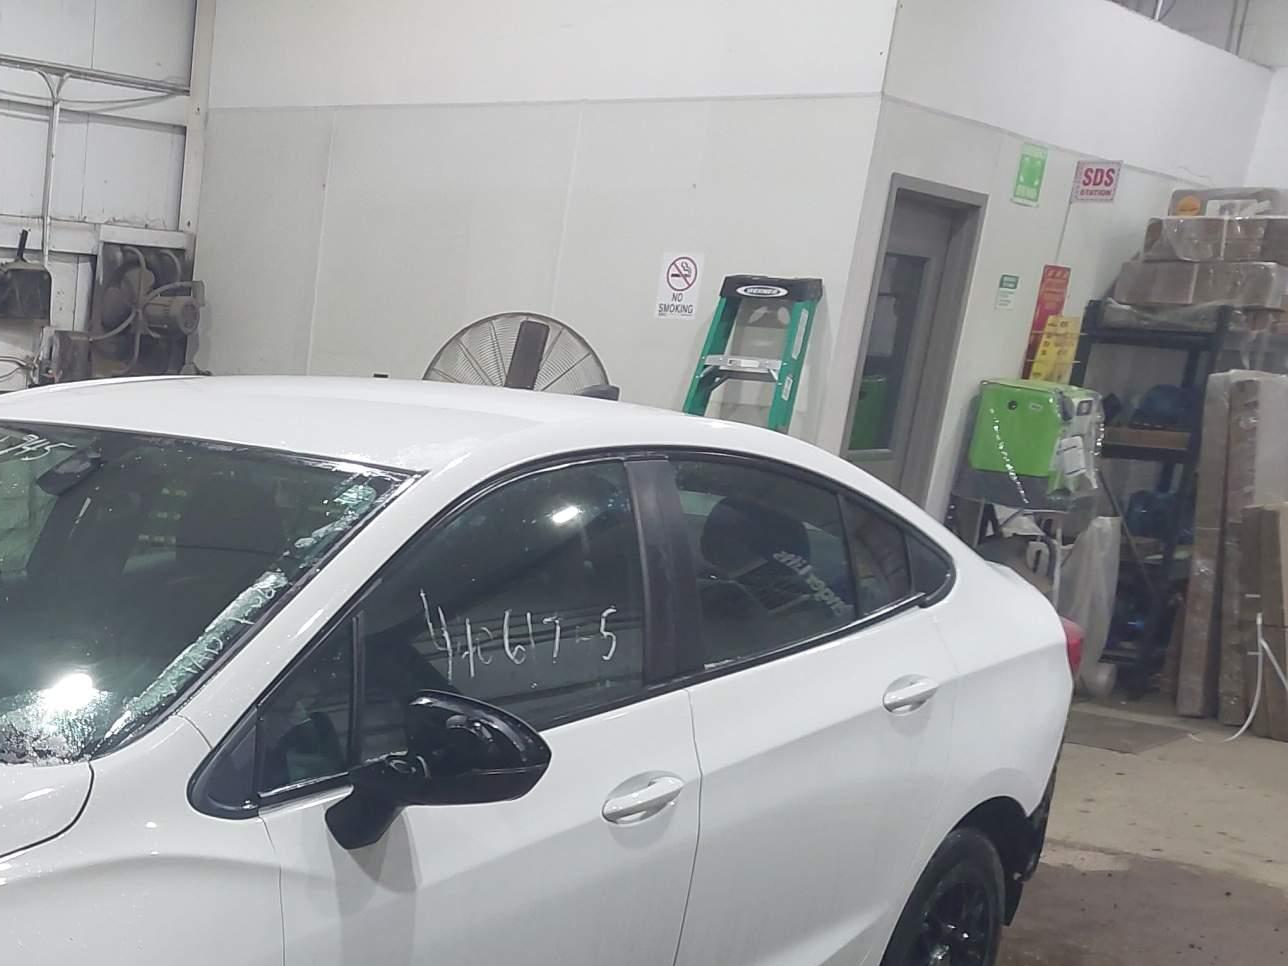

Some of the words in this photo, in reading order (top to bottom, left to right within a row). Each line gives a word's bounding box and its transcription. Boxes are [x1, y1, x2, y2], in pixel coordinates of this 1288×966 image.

[1082, 167, 1115, 187] SDS
[672, 292, 684, 302] NO
[658, 303, 693, 314] SMOKING
